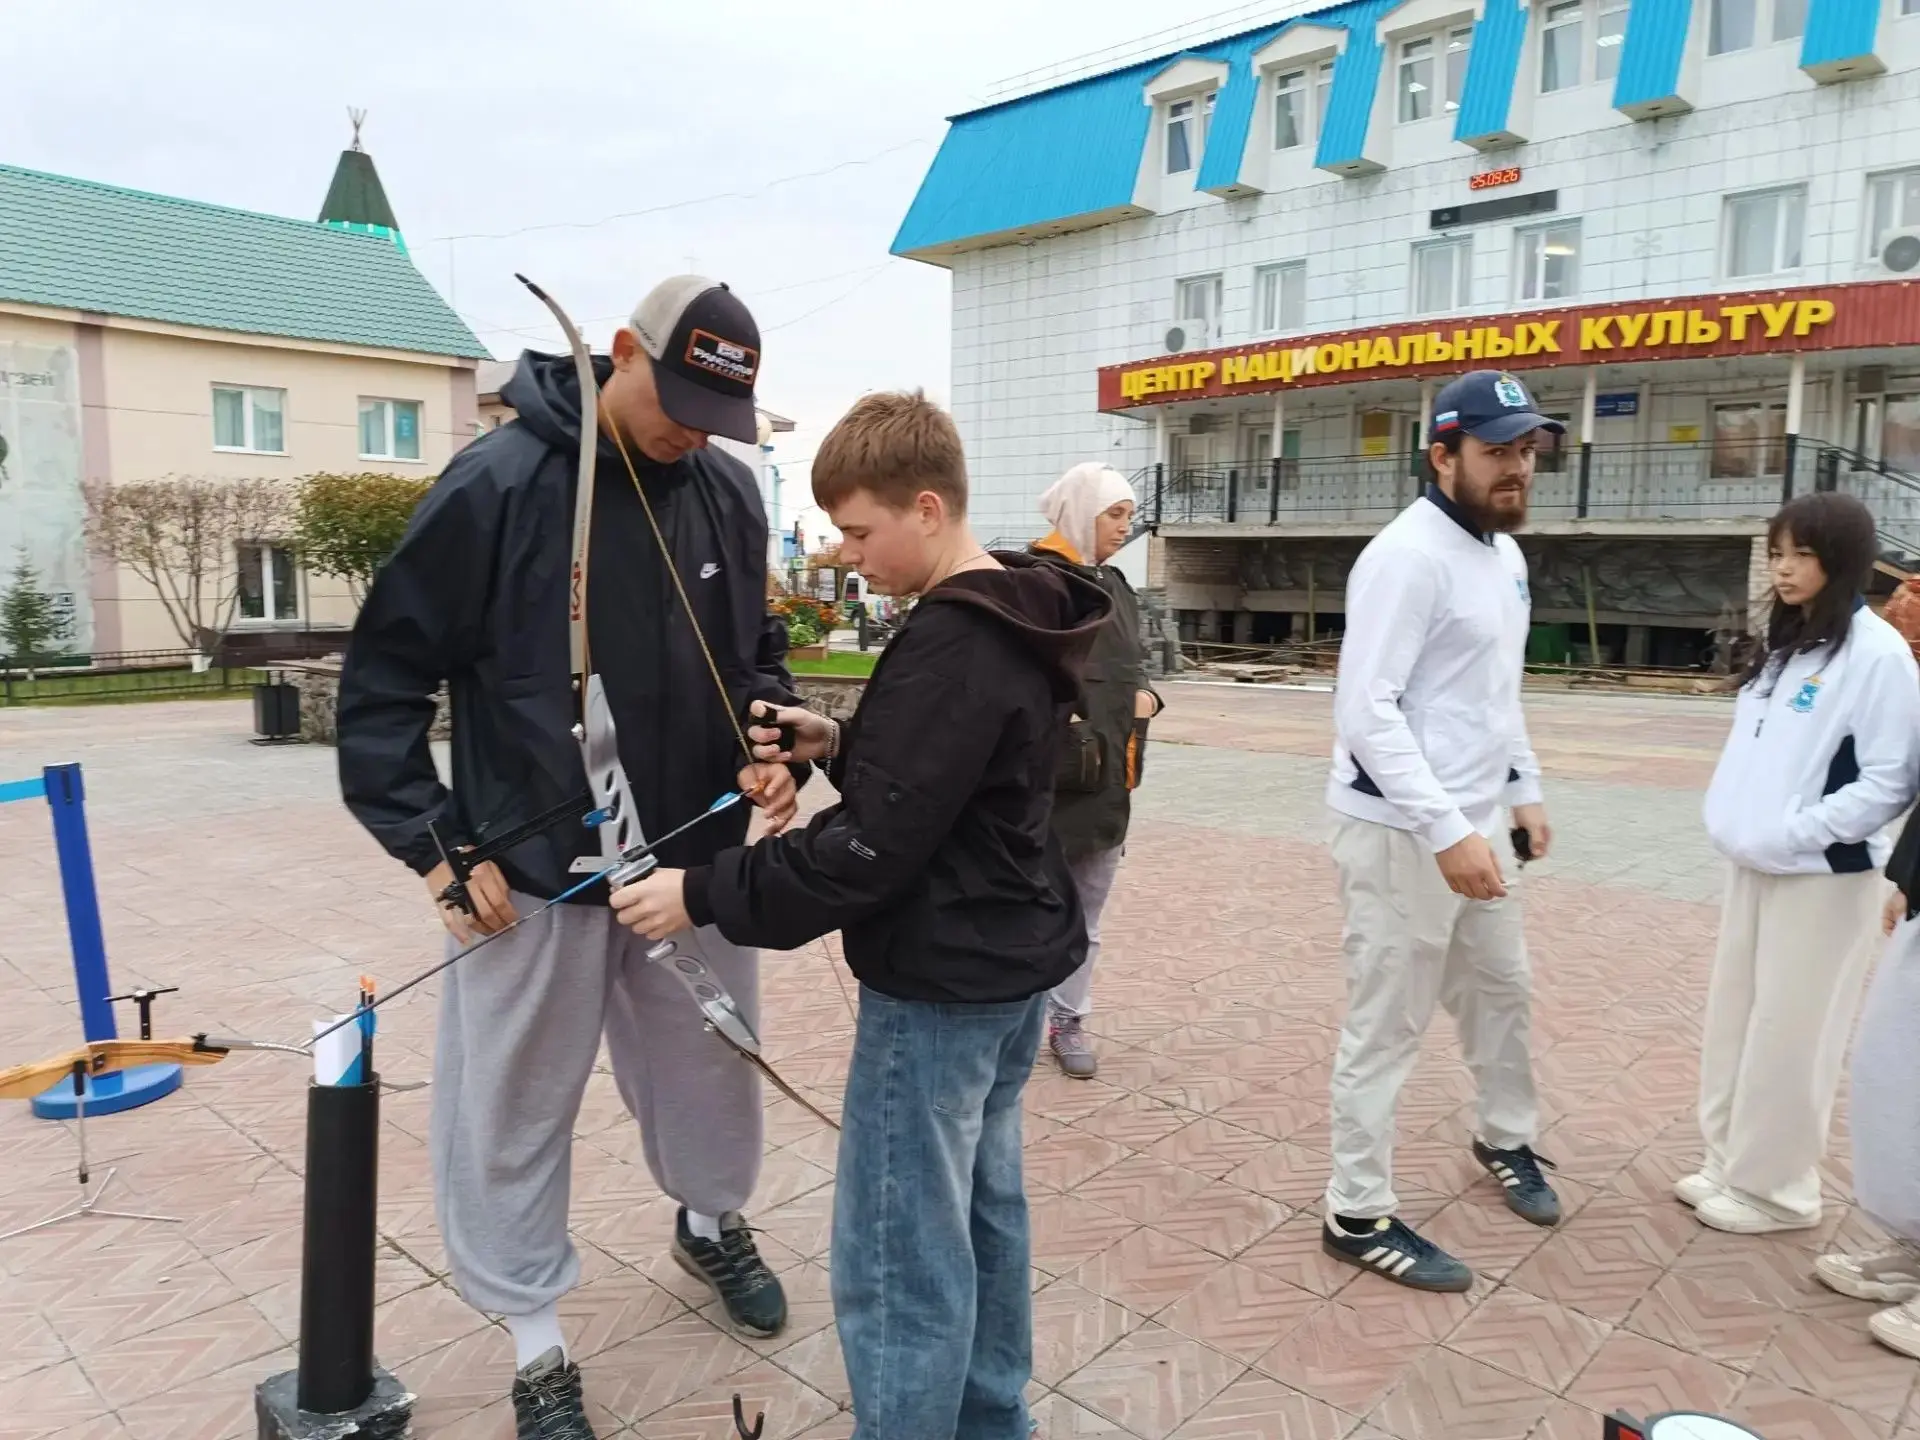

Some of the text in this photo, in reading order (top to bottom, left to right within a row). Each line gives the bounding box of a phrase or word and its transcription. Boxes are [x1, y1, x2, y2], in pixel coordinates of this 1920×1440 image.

[1470, 168, 1519, 189] 25.09.26
[1120, 299, 1836, 401] ЦЕНТР НАЦИОНАЛЬНЫХ КУЛЬТУР
